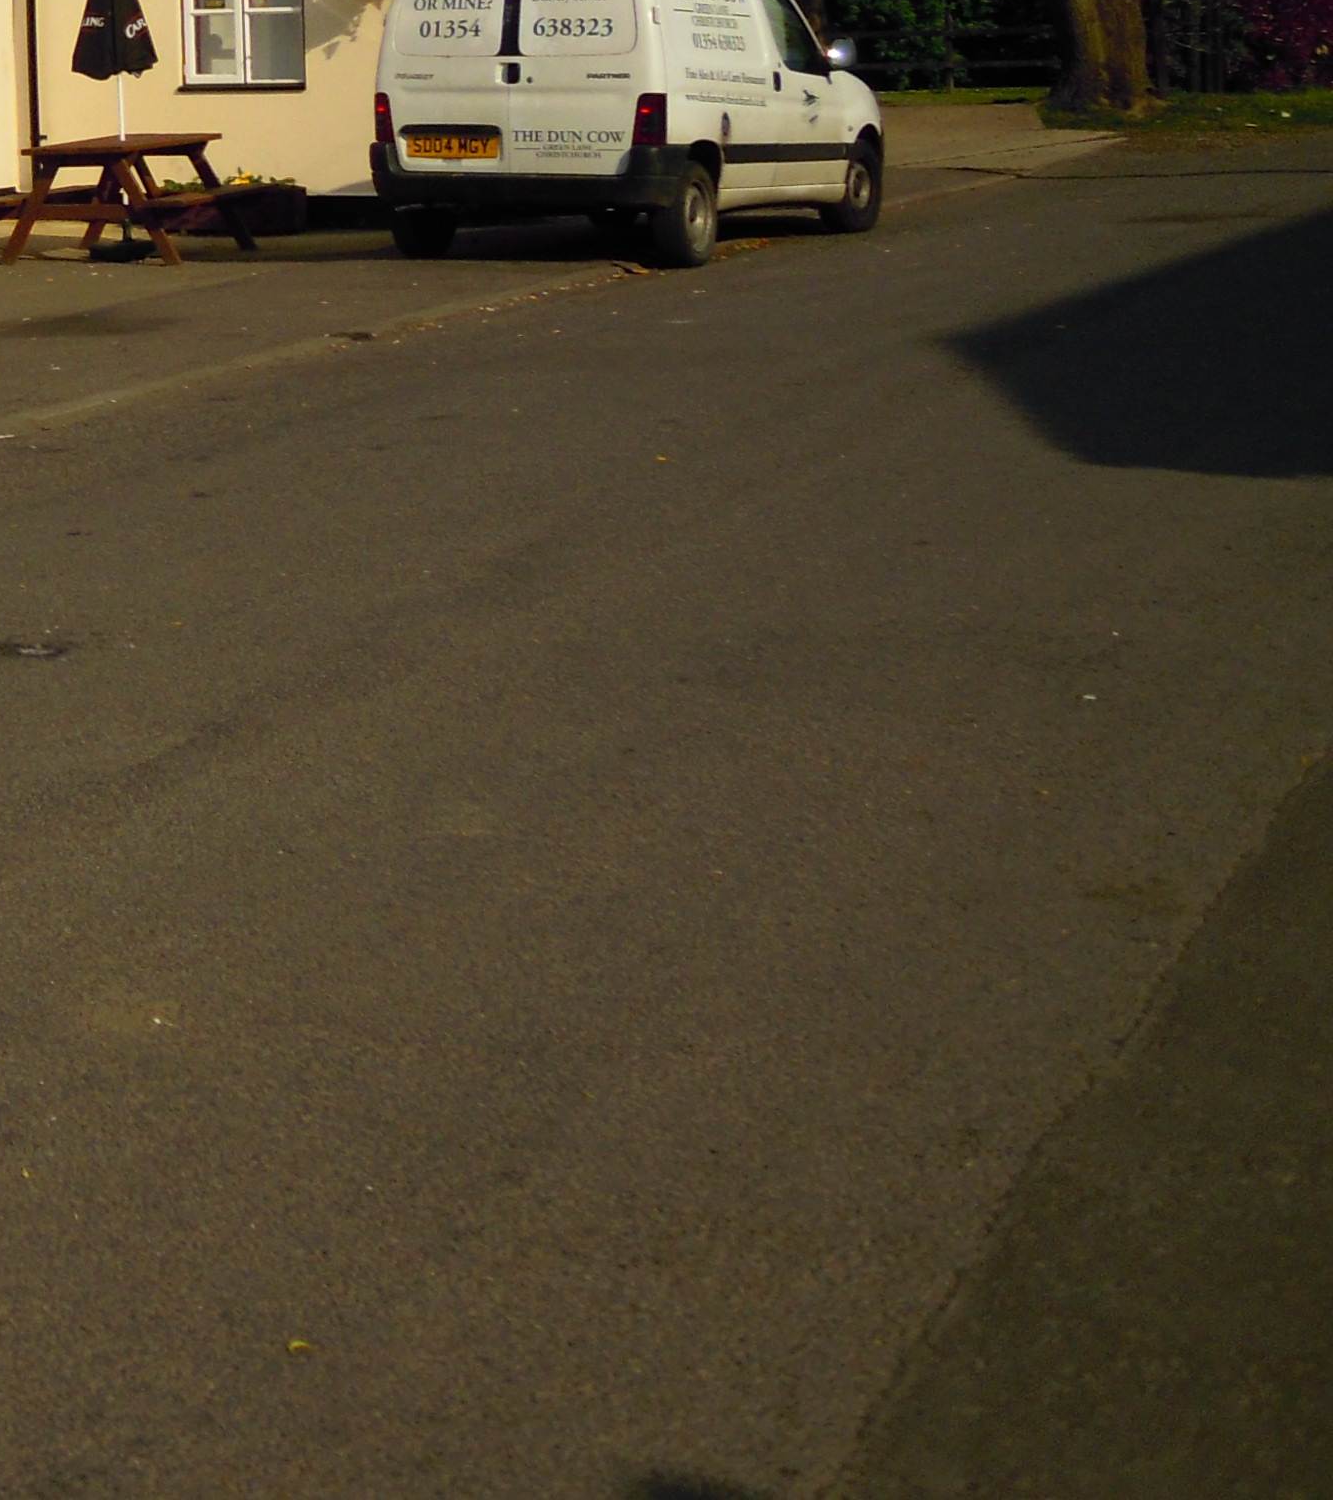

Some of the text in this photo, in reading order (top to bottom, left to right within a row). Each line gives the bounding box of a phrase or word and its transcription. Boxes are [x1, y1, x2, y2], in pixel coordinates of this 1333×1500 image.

[420, 18, 481, 38] 01354
[533, 16, 614, 37] 638323
[586, 72, 630, 80] PARTNER
[512, 130, 626, 143] THE DUN COW
[412, 137, 491, 154] SD04 MGY
